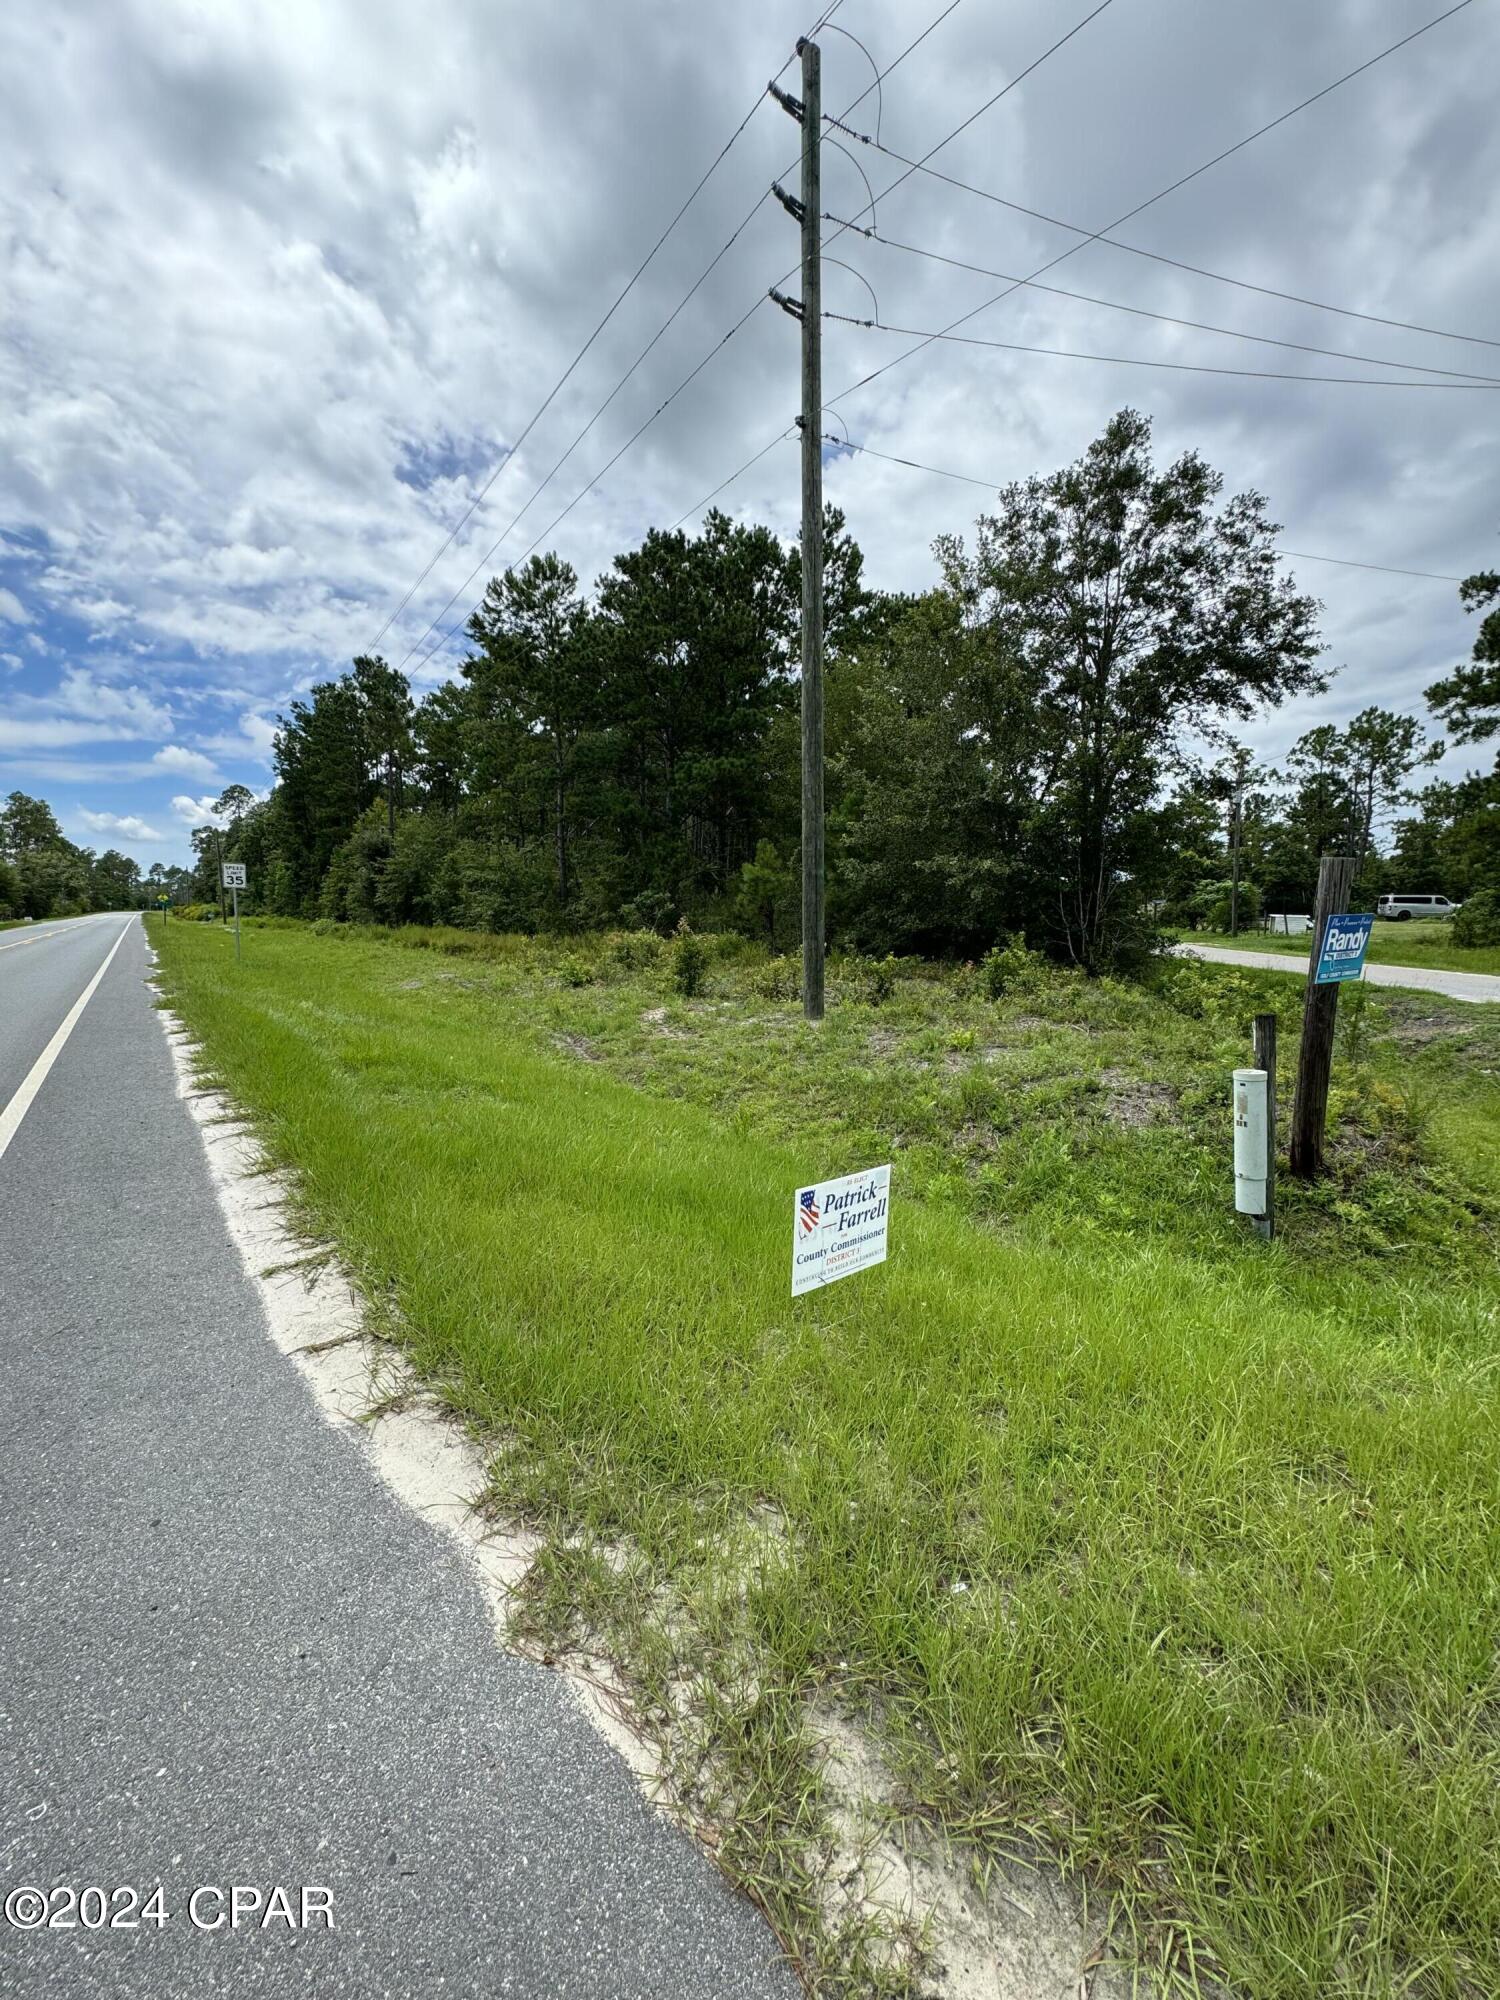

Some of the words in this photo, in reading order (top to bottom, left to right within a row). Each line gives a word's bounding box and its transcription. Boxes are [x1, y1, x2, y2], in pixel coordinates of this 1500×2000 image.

[226, 876, 244, 885] 35
[1326, 926, 1369, 952] Randy
[823, 1181, 878, 1215] Patrick
[838, 1197, 887, 1231] Farrell
[796, 1247, 829, 1265] County
[830, 1227, 885, 1253] Commissioner
[826, 1249, 857, 1266] DISTRICT
